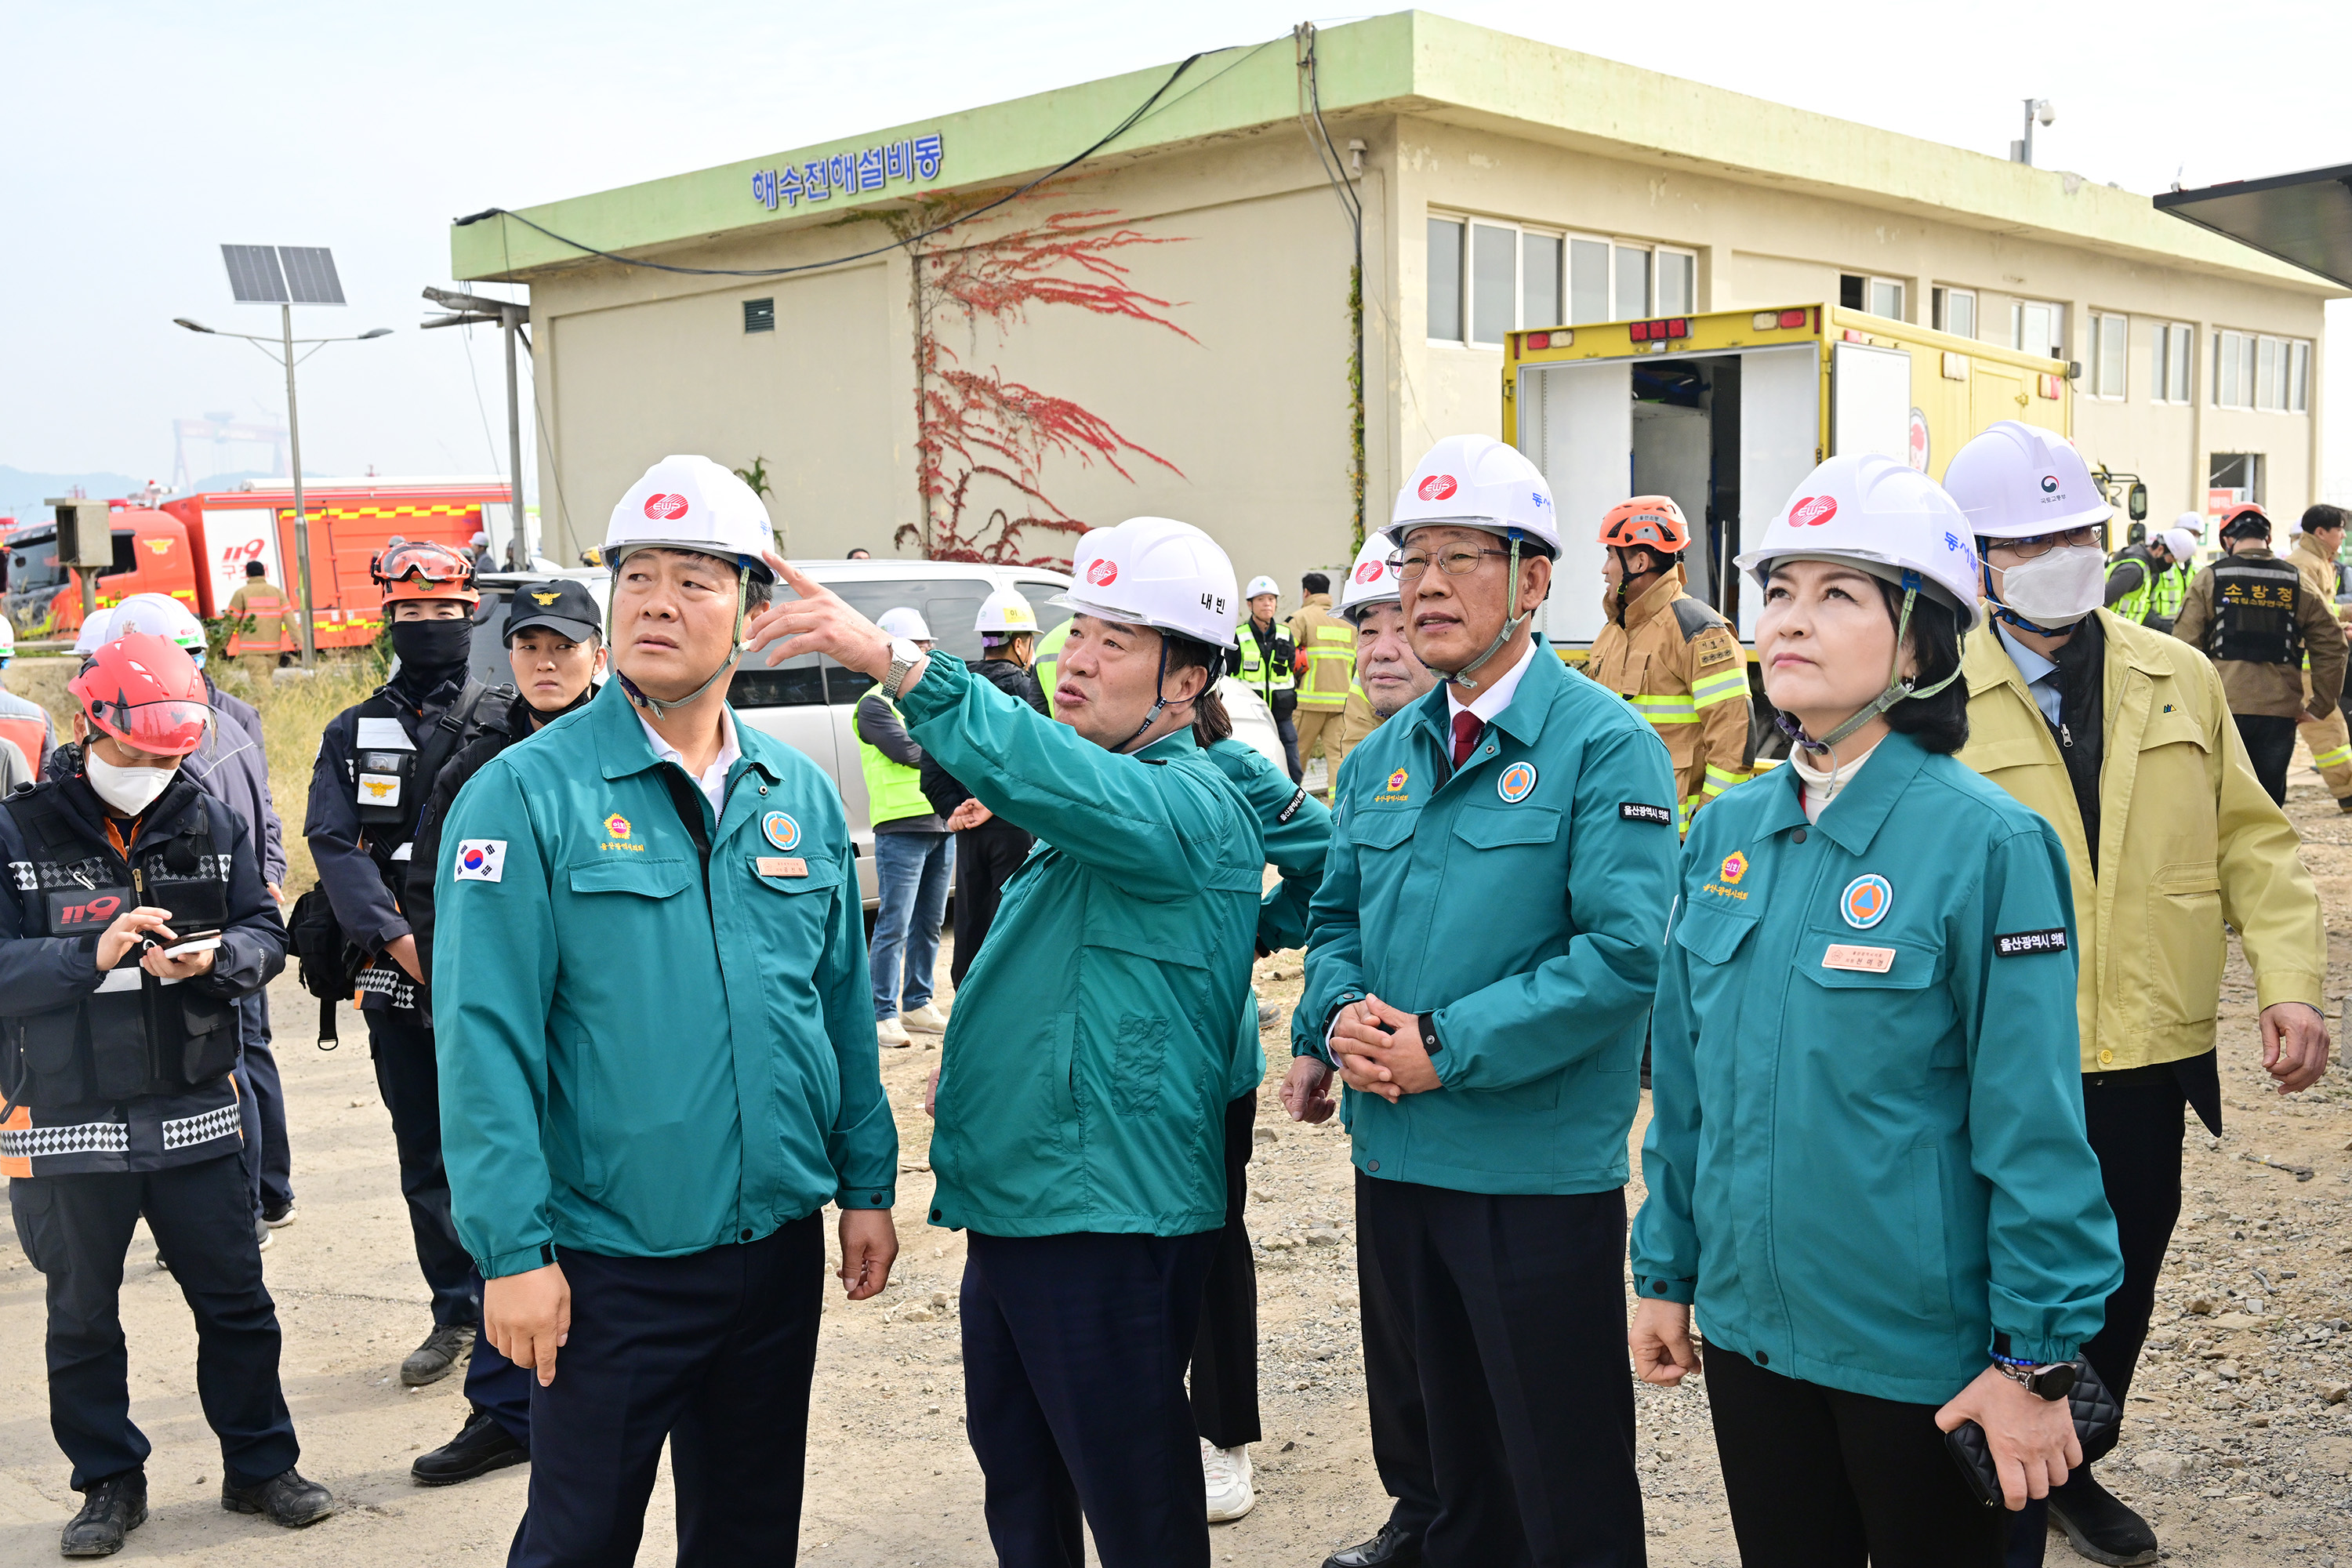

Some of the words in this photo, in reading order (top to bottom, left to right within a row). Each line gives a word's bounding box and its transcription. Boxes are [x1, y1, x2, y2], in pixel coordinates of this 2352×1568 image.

[750, 133, 942, 210] 해수전해설비동
[1425, 483, 1450, 492] EWP
[1532, 492, 1555, 517] 동서
[2040, 494, 2066, 503] 국토교통부
[653, 502, 681, 510] EWP
[1798, 505, 1828, 517] EWP
[223, 539, 265, 562] 119
[1093, 566, 1112, 578] EWP
[1360, 567, 1377, 577] EWP
[2224, 583, 2293, 602] 소방청
[1201, 593, 1225, 615] 내빈
[1624, 805, 1658, 819] 울산광역시
[1725, 862, 1740, 873] 의회
[60, 896, 122, 924] 119
[2000, 934, 2050, 952] 울산광역시
